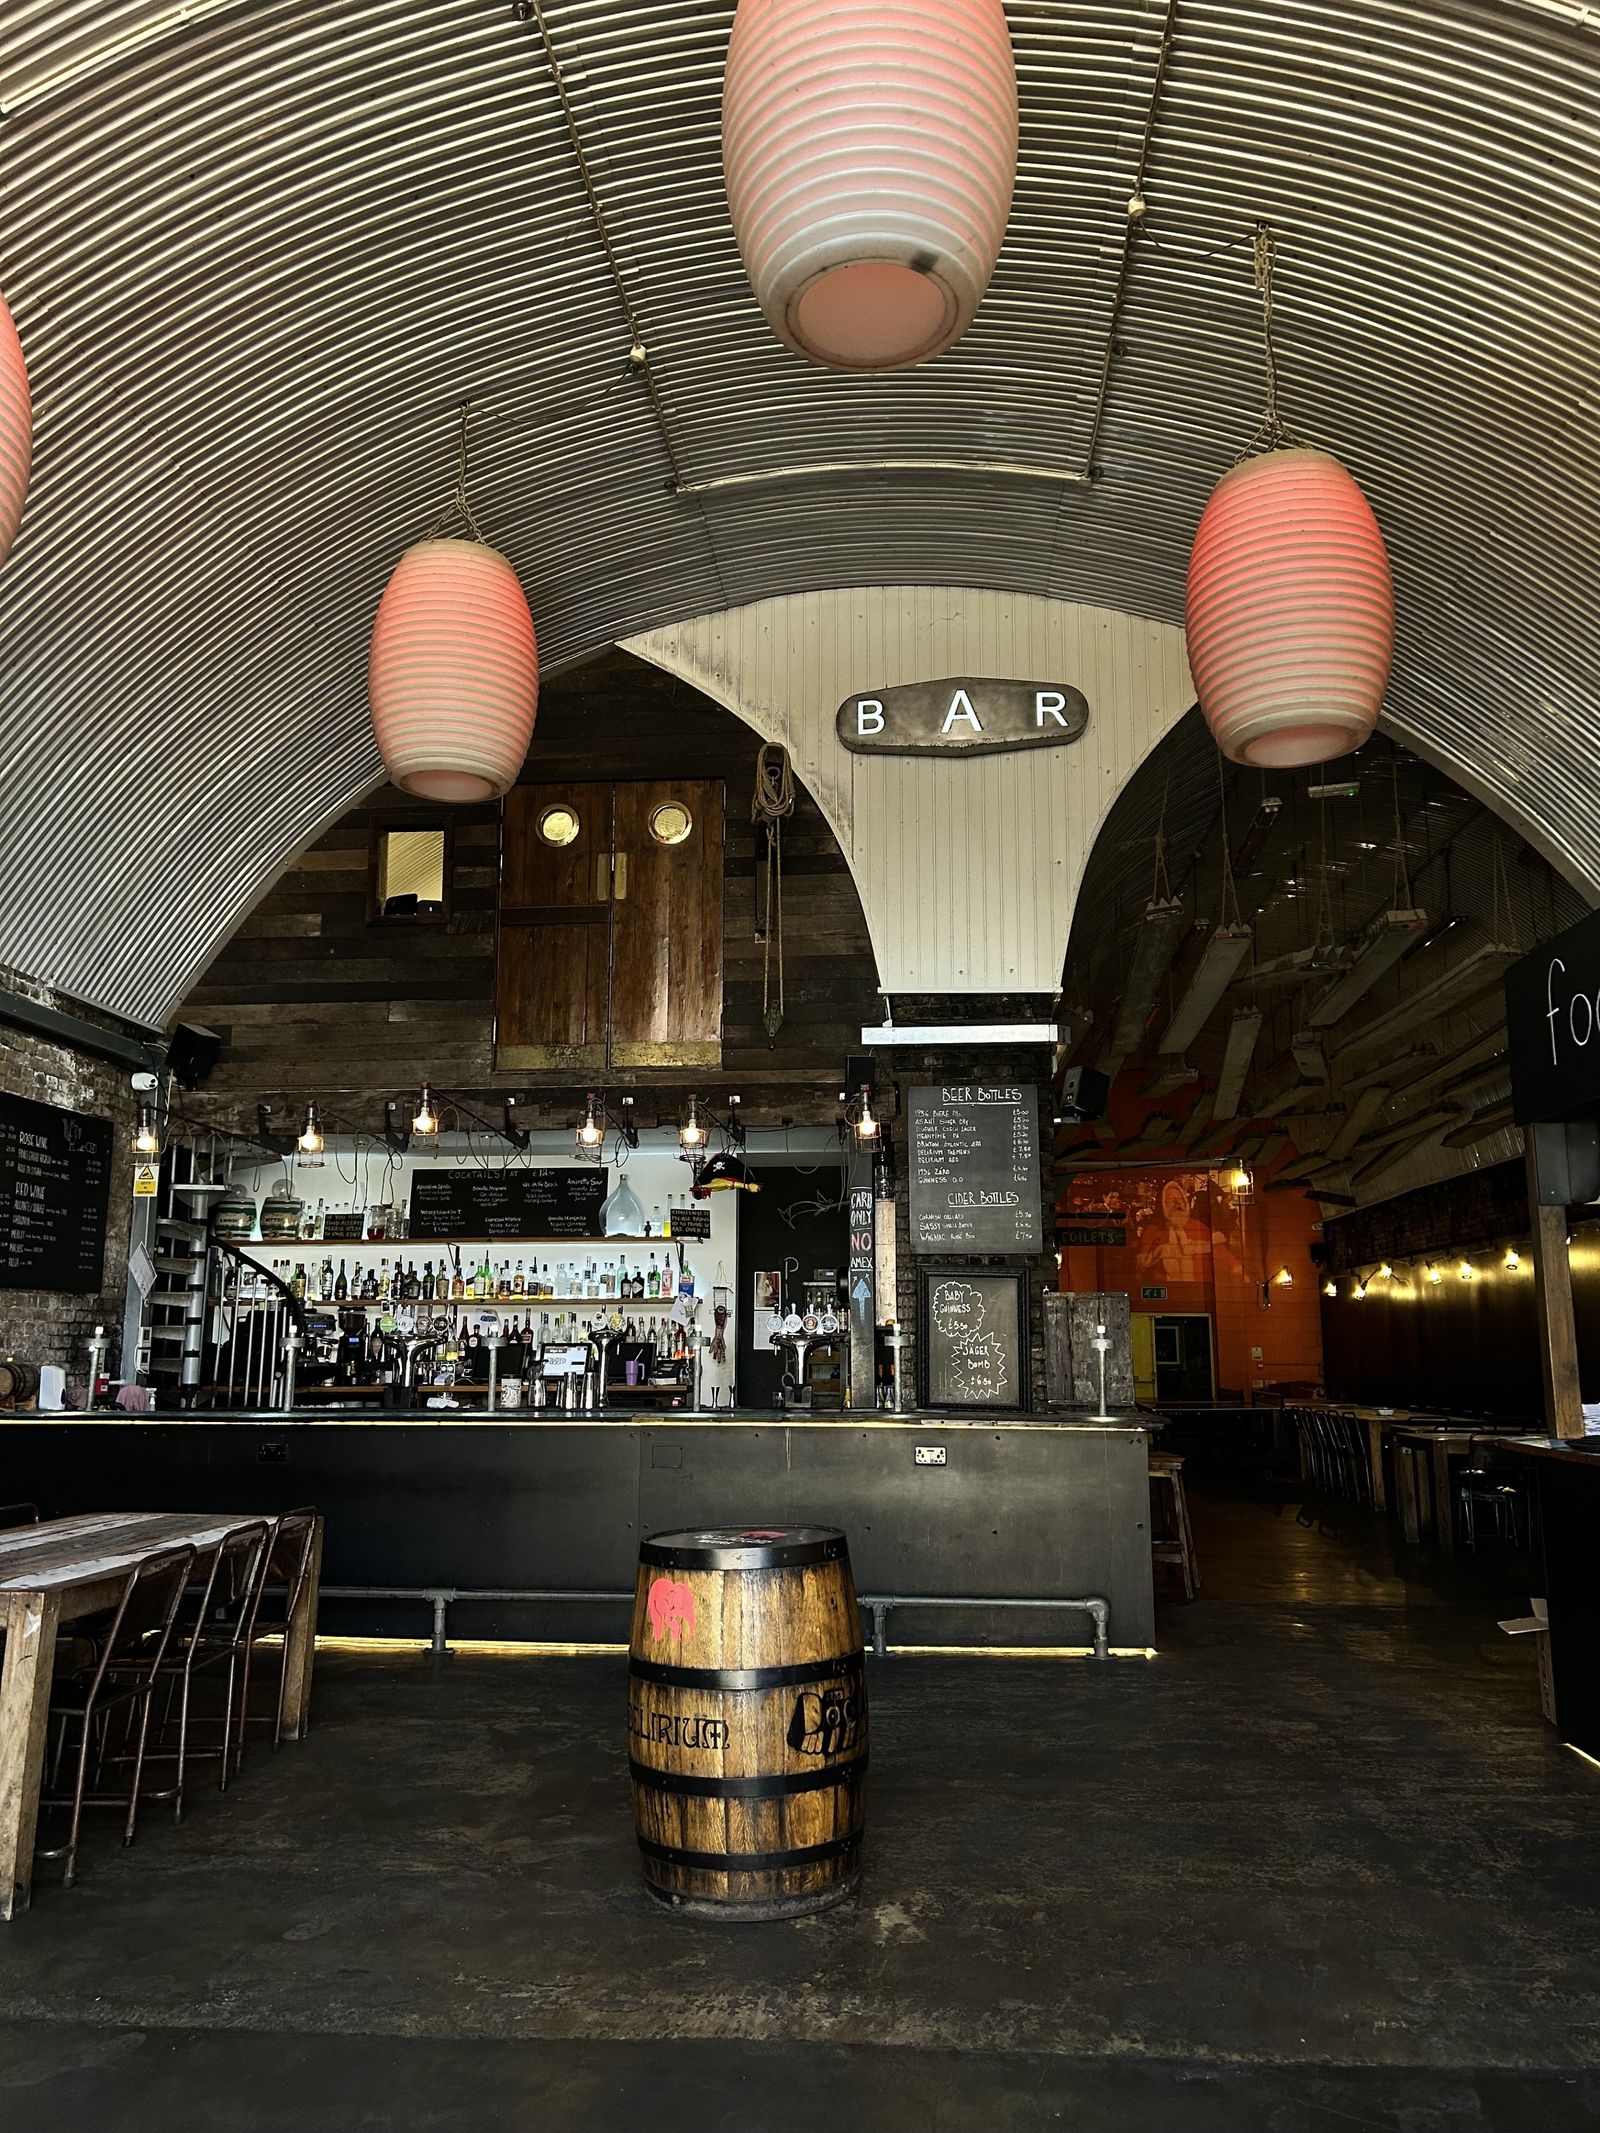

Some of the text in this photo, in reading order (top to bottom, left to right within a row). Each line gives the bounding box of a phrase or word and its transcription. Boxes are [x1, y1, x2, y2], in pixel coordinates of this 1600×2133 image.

[857, 689, 1069, 735] BAR
[1547, 959, 1600, 1065] fo
[942, 1087, 1022, 1102] BEER BOTTLES
[917, 1148, 944, 1156] DELIRIUM
[917, 1156, 945, 1164] DELIRIUM
[918, 1176, 948, 1184] GUINNESS
[16, 1181, 29, 1197] RED
[30, 1184, 46, 1200] WINE
[850, 1191, 873, 1209] CARD
[947, 1191, 1020, 1204] CIDER BOTTLES
[850, 1210, 872, 1227] ONLY
[919, 1222, 941, 1231] SASSY
[851, 1232, 872, 1251] NO
[1061, 1231, 1115, 1244] TOILETS
[850, 1256, 874, 1268] AMEX
[944, 1290, 965, 1303] BABY
[939, 1302, 971, 1314] GUINNESS
[962, 1343, 990, 1357] JÄGER
